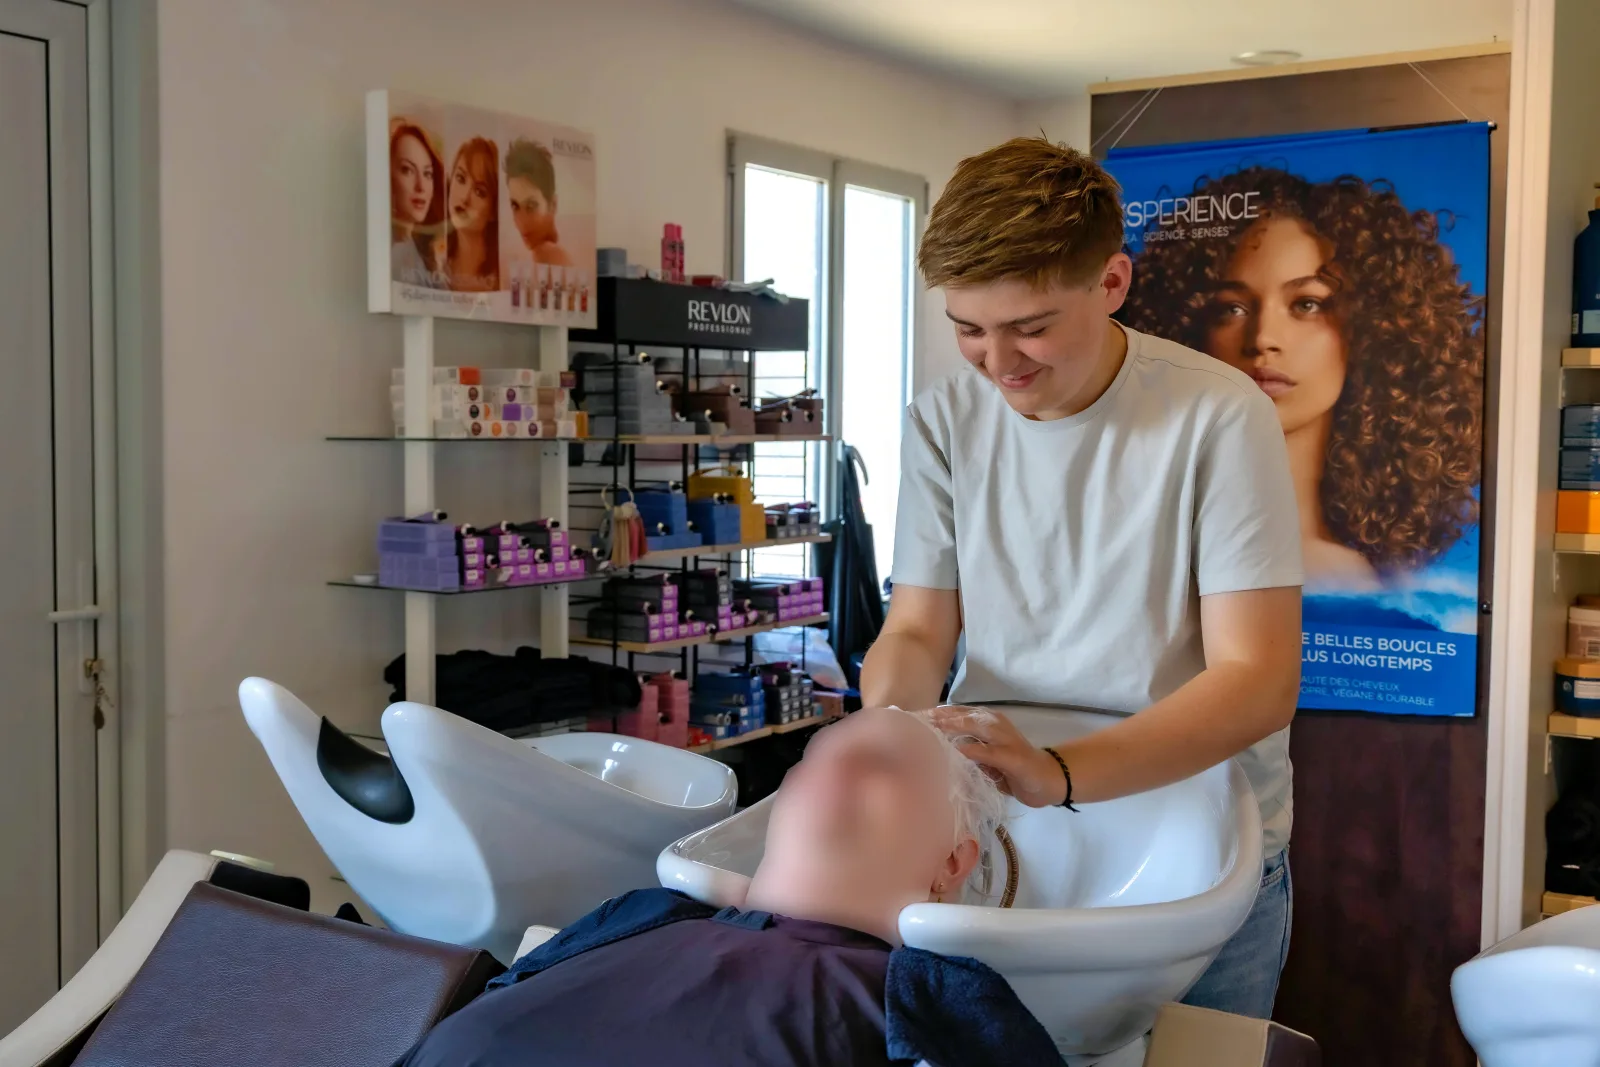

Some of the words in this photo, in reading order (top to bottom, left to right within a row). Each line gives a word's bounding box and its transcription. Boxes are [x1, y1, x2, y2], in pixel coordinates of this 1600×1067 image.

[1143, 229, 1186, 243] SCIENCE
[688, 299, 751, 324] REVLON
[688, 321, 752, 335] PROFESSIONAL
[1314, 632, 1374, 650] BELLES
[1377, 637, 1457, 657] BOUCLES
[1332, 651, 1433, 672] LONGTEMPS
[1329, 676, 1350, 687] DES
[1351, 679, 1400, 692] CHEVEUX
[1376, 692, 1385, 702] &
[1385, 693, 1435, 708] DURABLE
